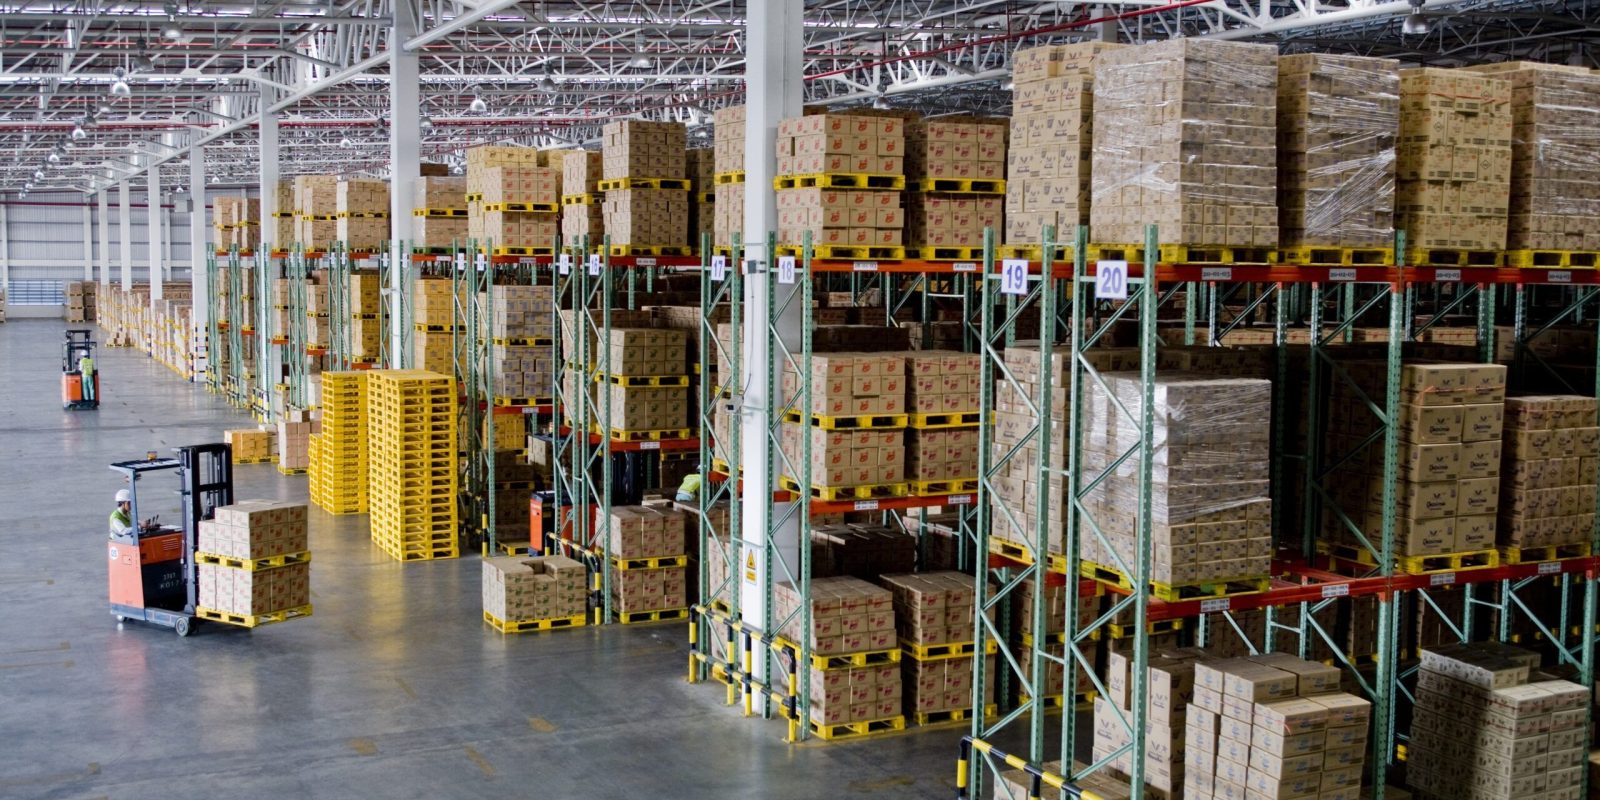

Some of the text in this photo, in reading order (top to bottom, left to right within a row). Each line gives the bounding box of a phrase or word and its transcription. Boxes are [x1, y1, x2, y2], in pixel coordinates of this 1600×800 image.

[714, 260, 723, 277] 17
[781, 261, 792, 280] 18
[1007, 265, 1023, 290] 19
[1101, 267, 1122, 293] 20
